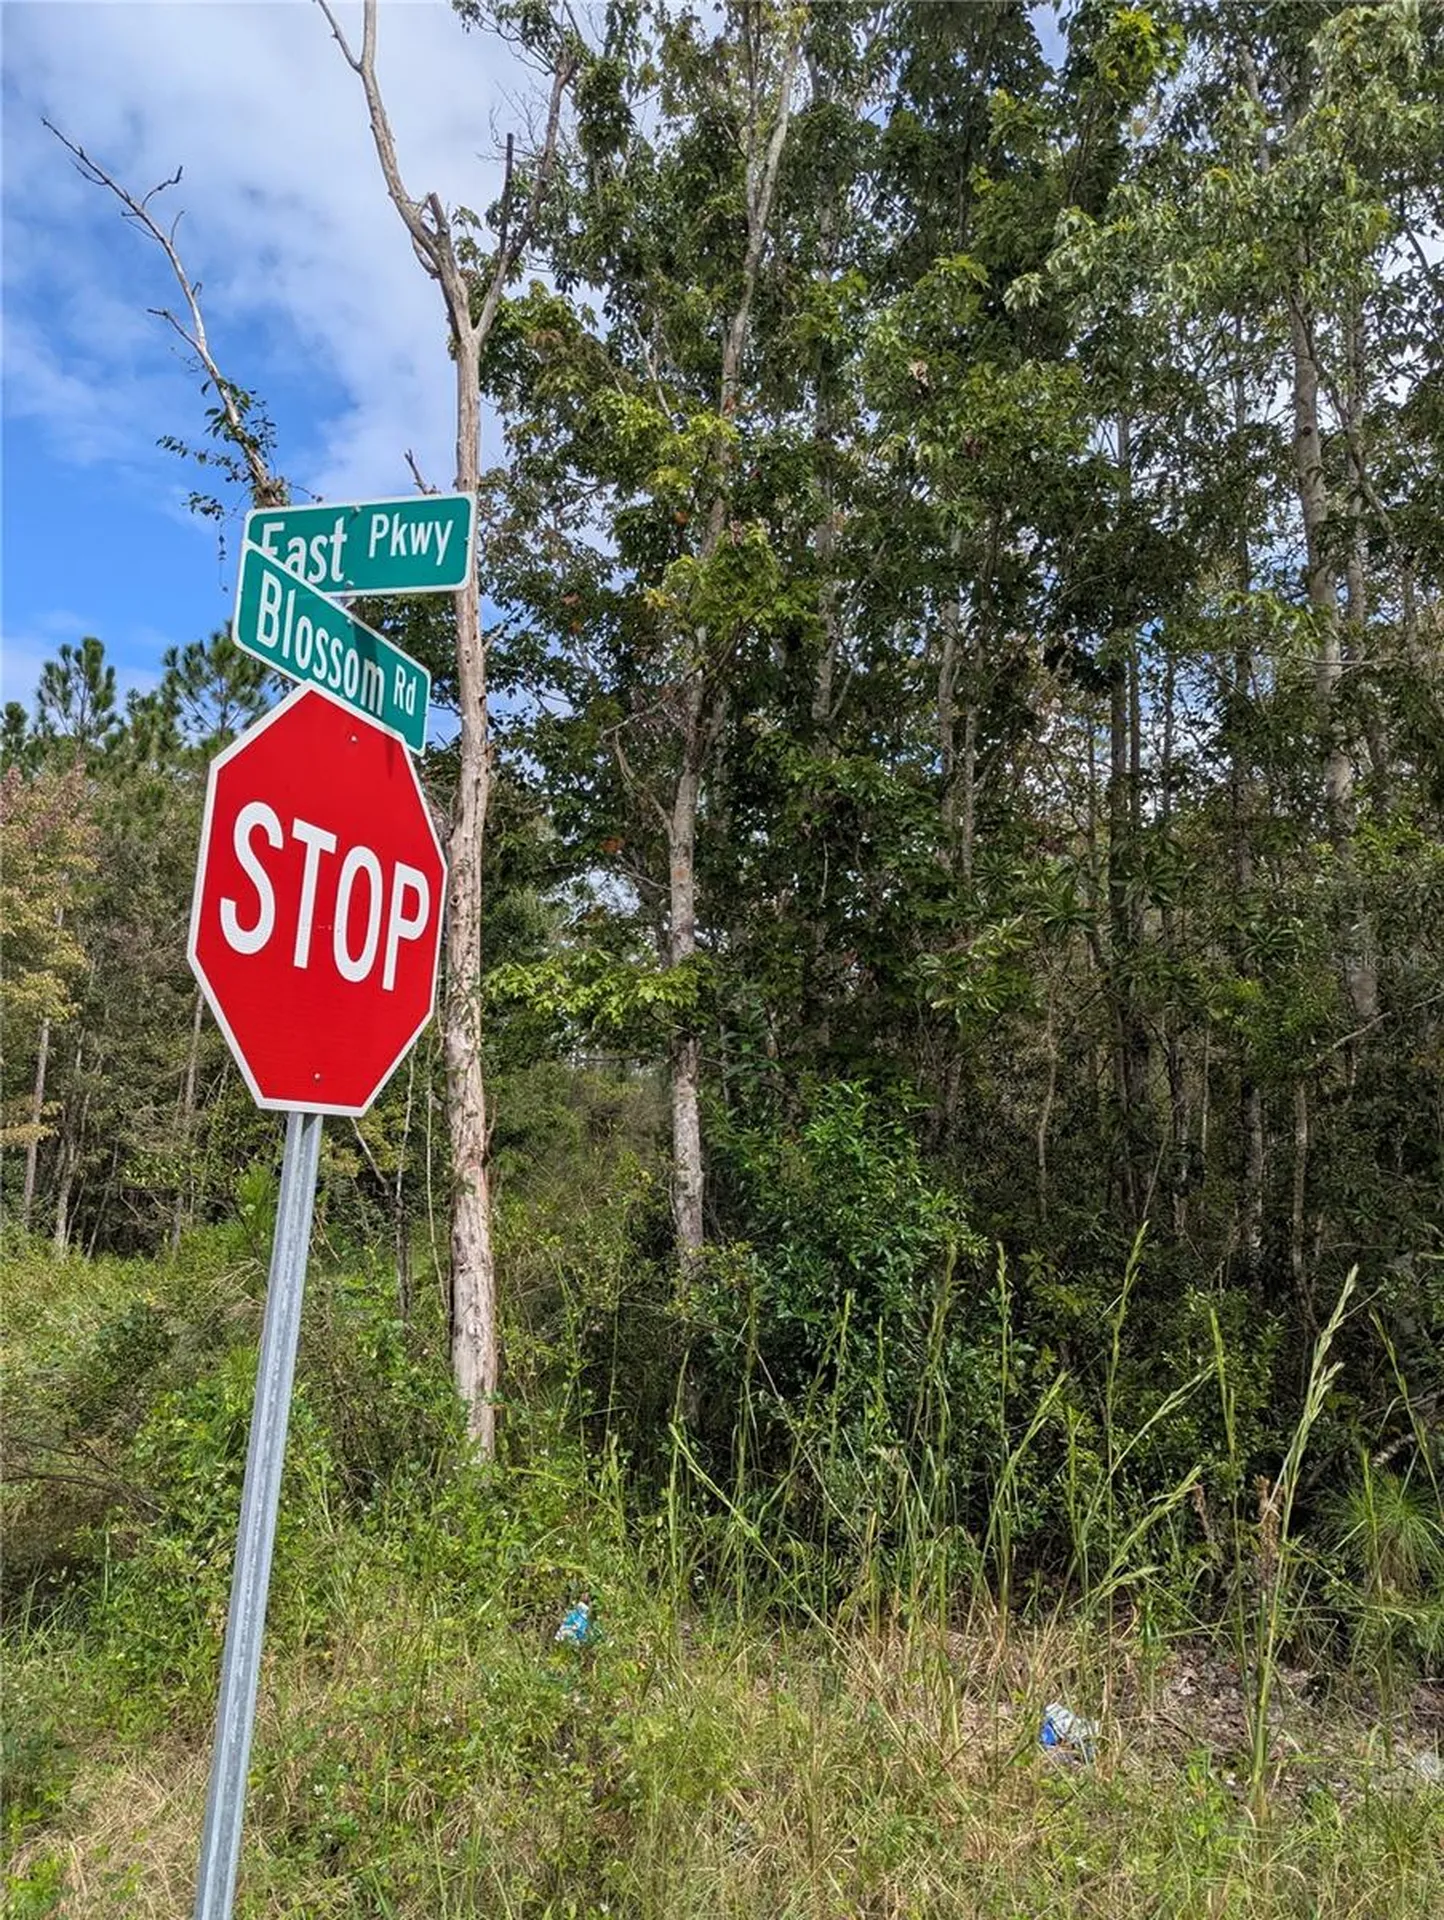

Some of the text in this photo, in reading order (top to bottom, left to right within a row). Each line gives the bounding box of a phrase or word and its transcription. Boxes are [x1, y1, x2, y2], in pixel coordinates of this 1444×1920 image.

[261, 512, 454, 585] East Pkwy
[256, 568, 417, 718] Blossom Rd
[219, 800, 431, 993] STOP
